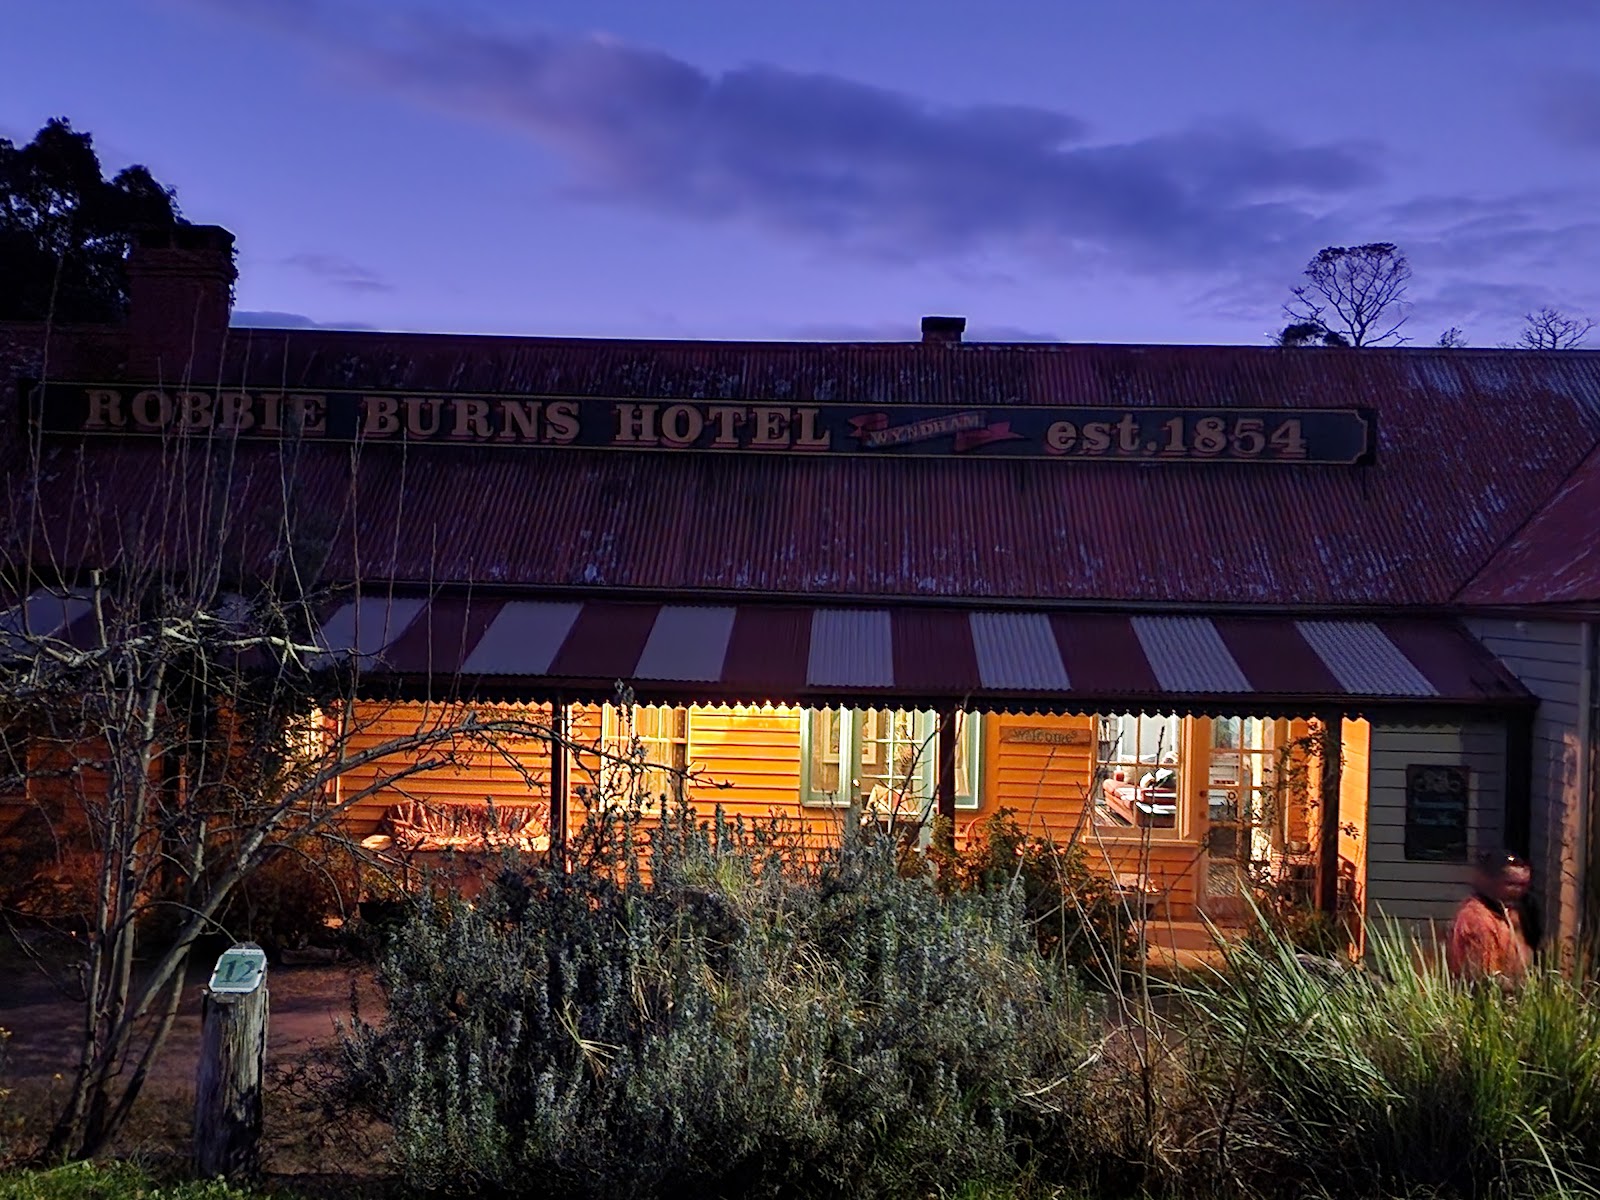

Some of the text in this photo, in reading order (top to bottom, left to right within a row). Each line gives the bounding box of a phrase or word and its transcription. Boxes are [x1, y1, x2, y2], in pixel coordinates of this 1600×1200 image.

[83, 388, 831, 451] ROBBIE BURNS HOTEL
[870, 414, 980, 444] WYNDHAM
[220, 960, 256, 982] 12
